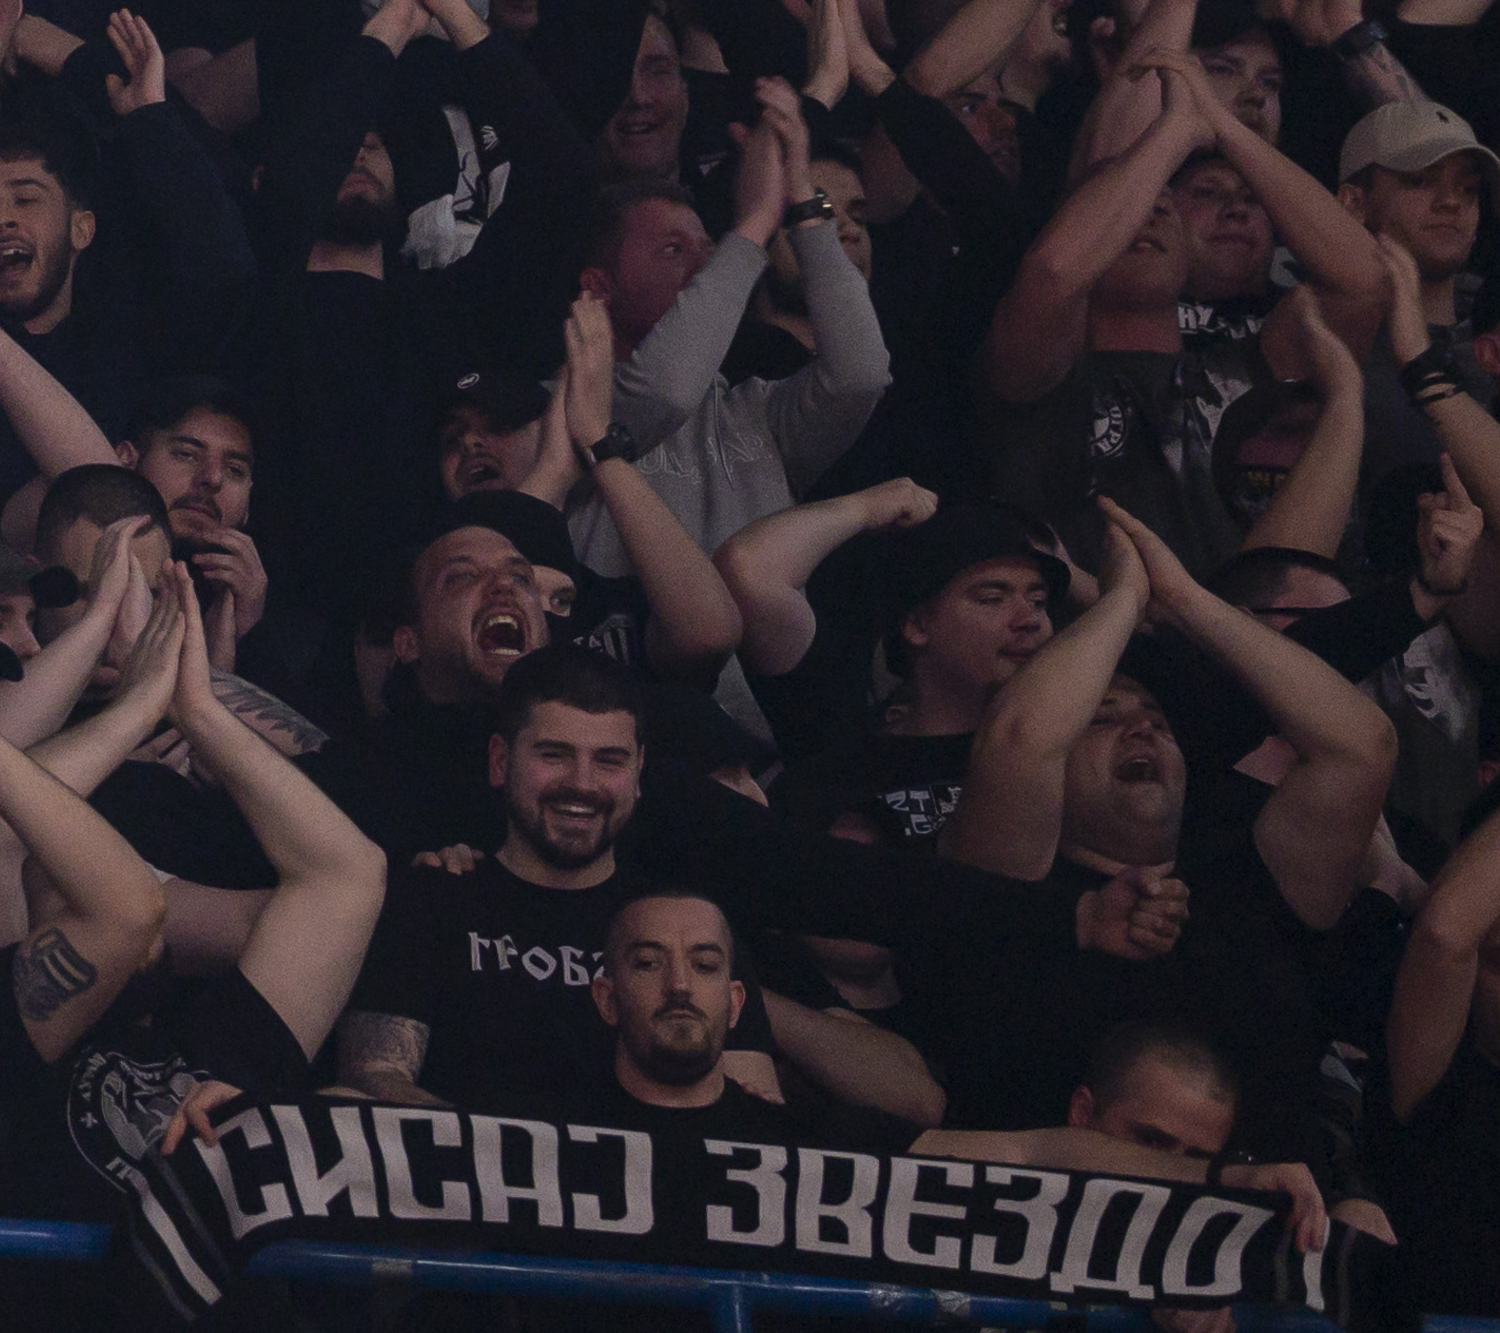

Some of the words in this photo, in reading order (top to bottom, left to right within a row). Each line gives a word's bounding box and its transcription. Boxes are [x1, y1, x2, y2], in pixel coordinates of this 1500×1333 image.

[468, 931, 606, 988] ГРОБ
[213, 1104, 654, 1241] СИСАЈ
[707, 1139, 1275, 1306] ЗВЕЗДО
